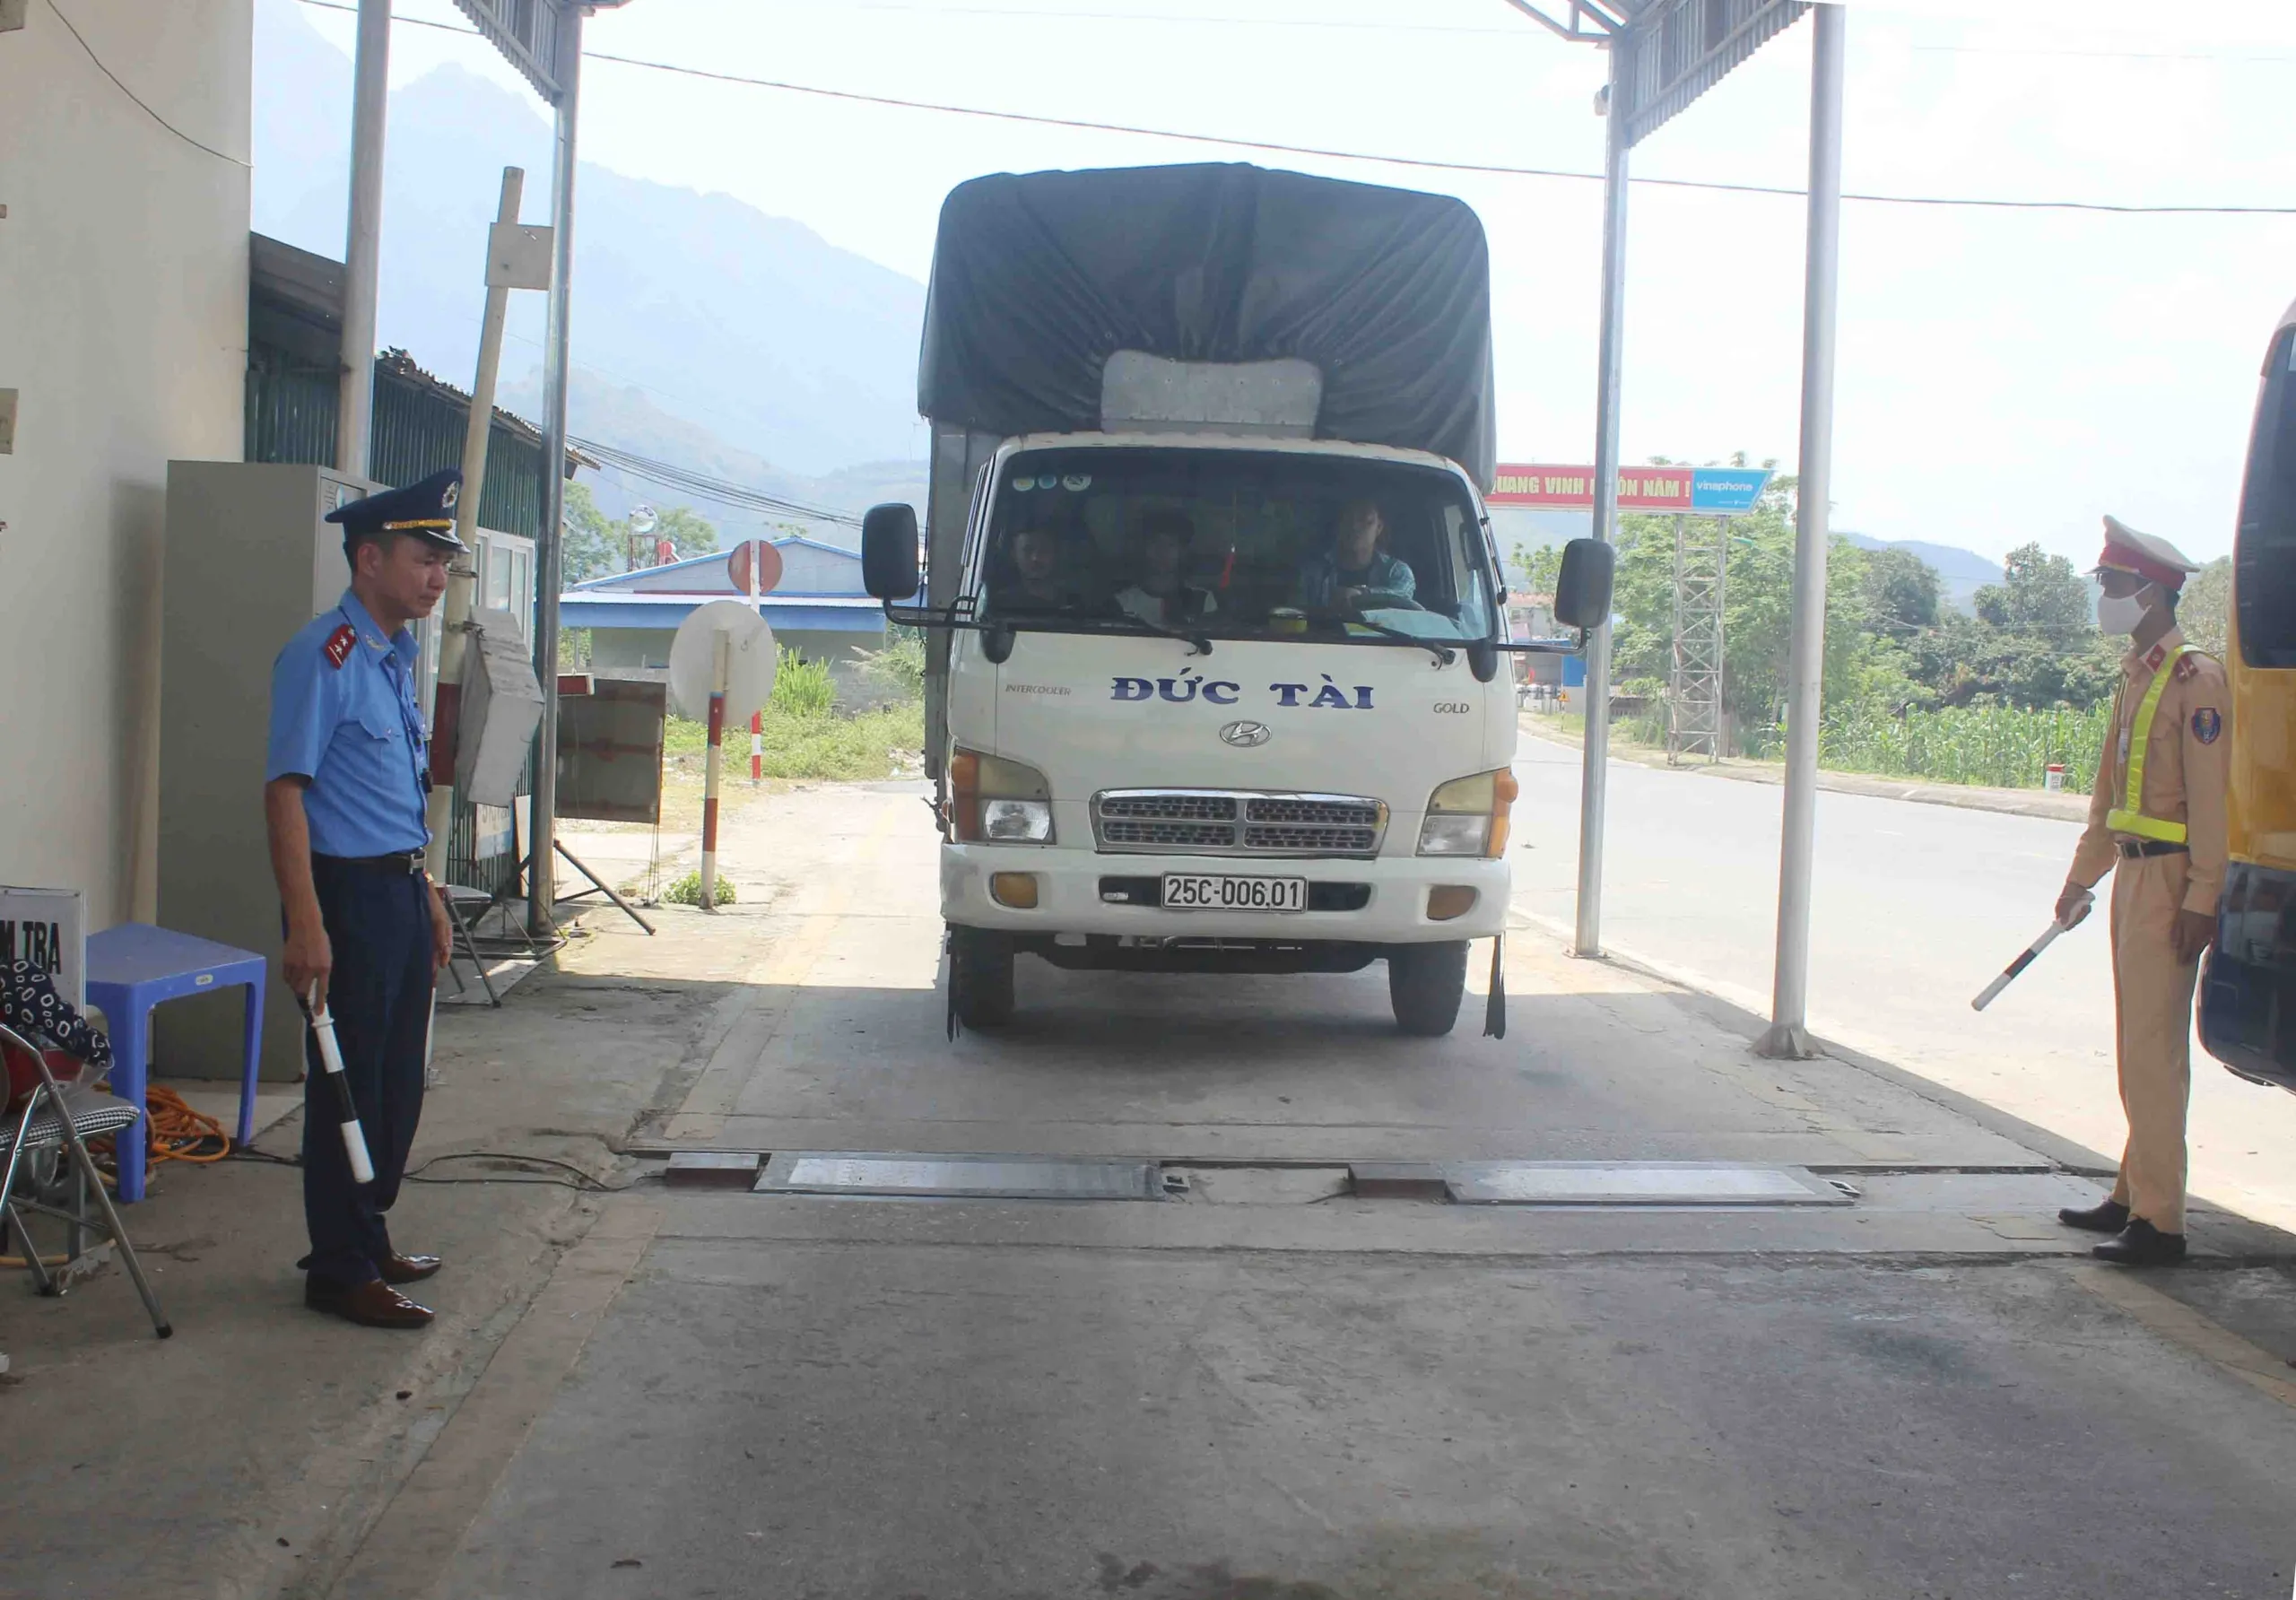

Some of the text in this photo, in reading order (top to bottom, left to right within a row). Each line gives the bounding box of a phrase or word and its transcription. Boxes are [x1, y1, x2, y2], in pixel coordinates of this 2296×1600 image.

[1492, 475, 1540, 494] UANG
[1544, 476, 1584, 495] VINH
[1643, 477, 1679, 497] NĂM
[1697, 481, 1753, 492] vinaphone
[1005, 684, 1072, 696] INTERCOOLER
[1110, 667, 1374, 709] ĐỨC TÀI
[1433, 702, 1470, 714] GOLD
[1168, 878, 1299, 908] 25C-006.01
[22, 921, 61, 975] TRA
